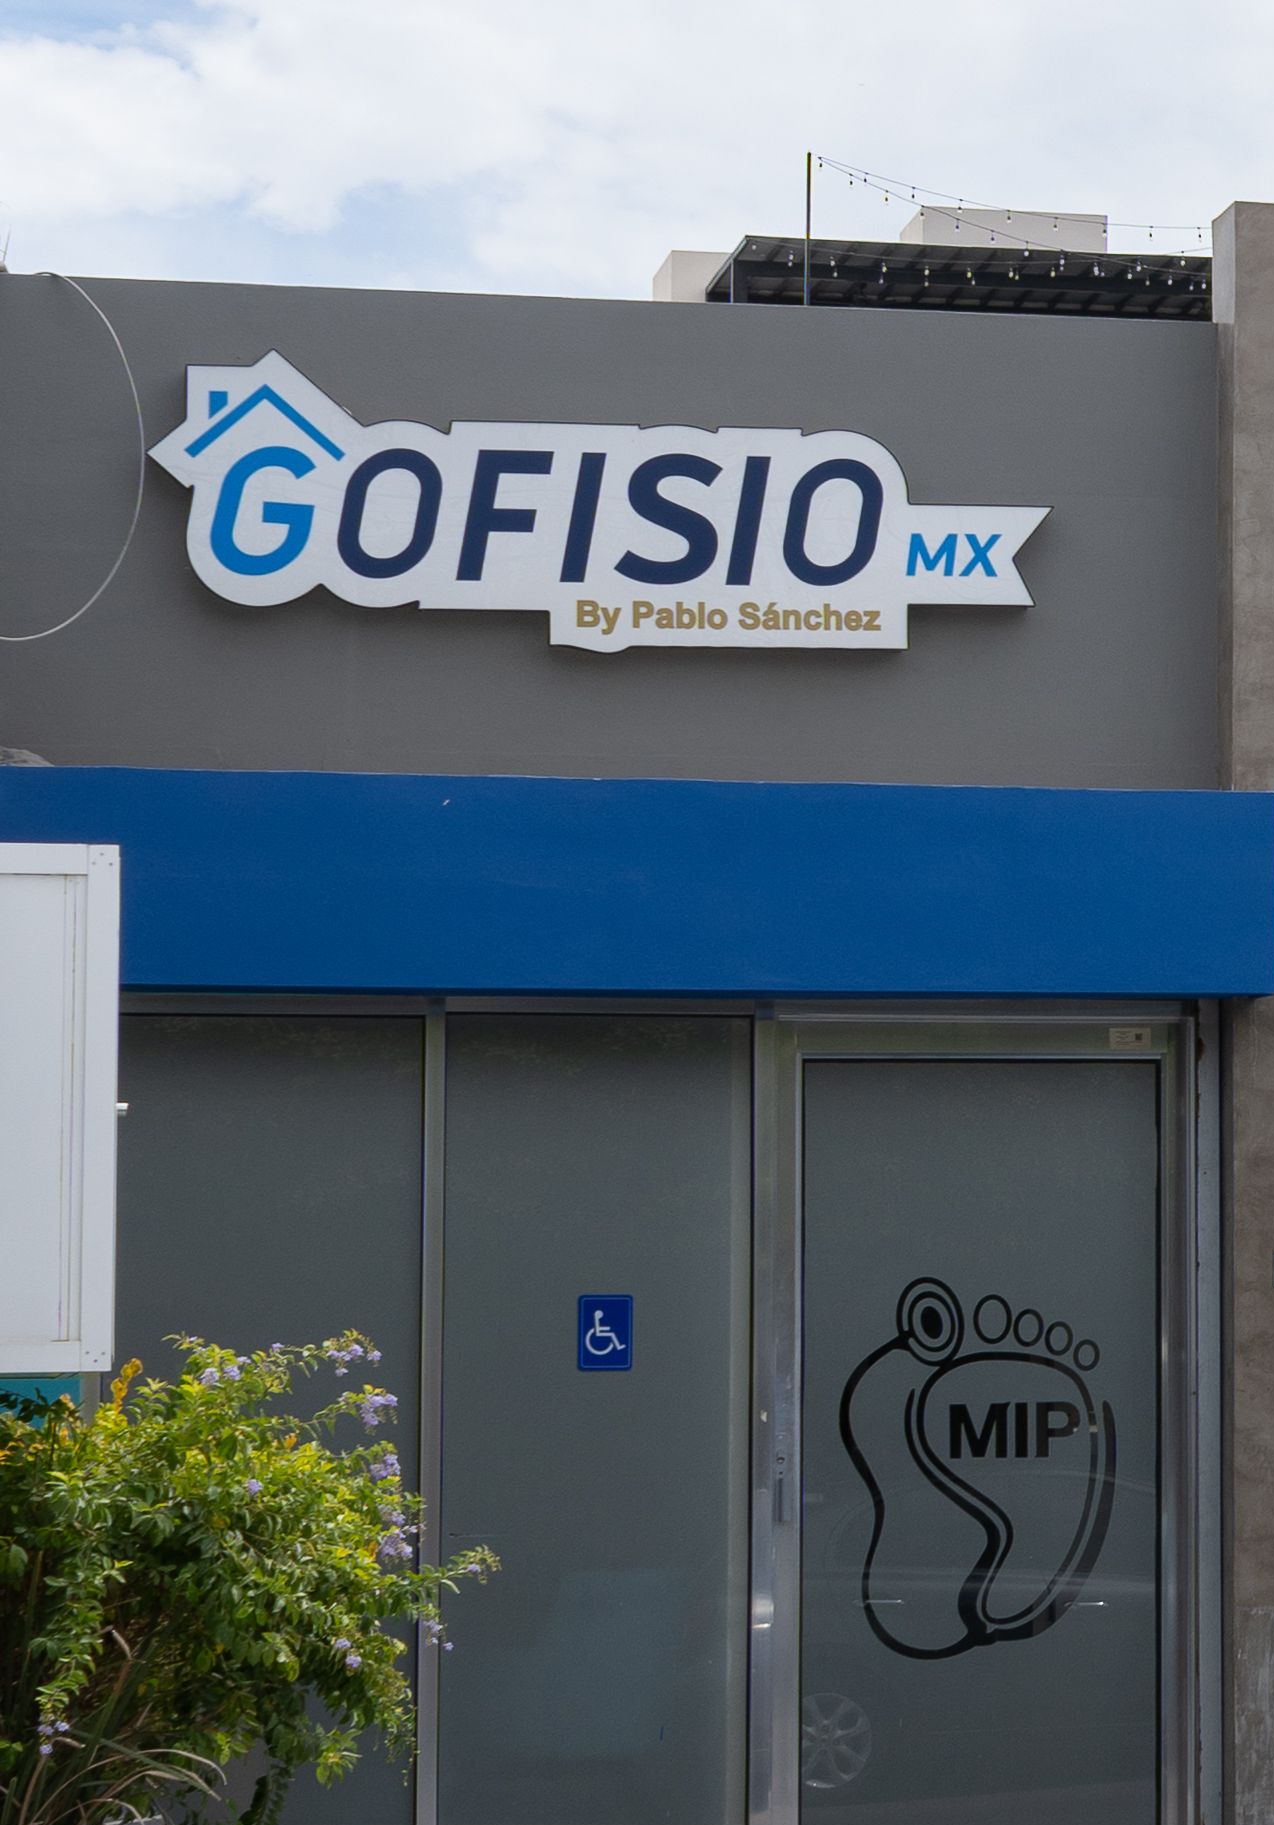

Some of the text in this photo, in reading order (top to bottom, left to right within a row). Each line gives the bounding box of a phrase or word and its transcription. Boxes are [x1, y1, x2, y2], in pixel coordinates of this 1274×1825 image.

[209, 445, 1003, 587] GOFISIO MX
[576, 600, 881, 635] By Pablo Sánchez
[949, 1401, 1081, 1459] MIP
